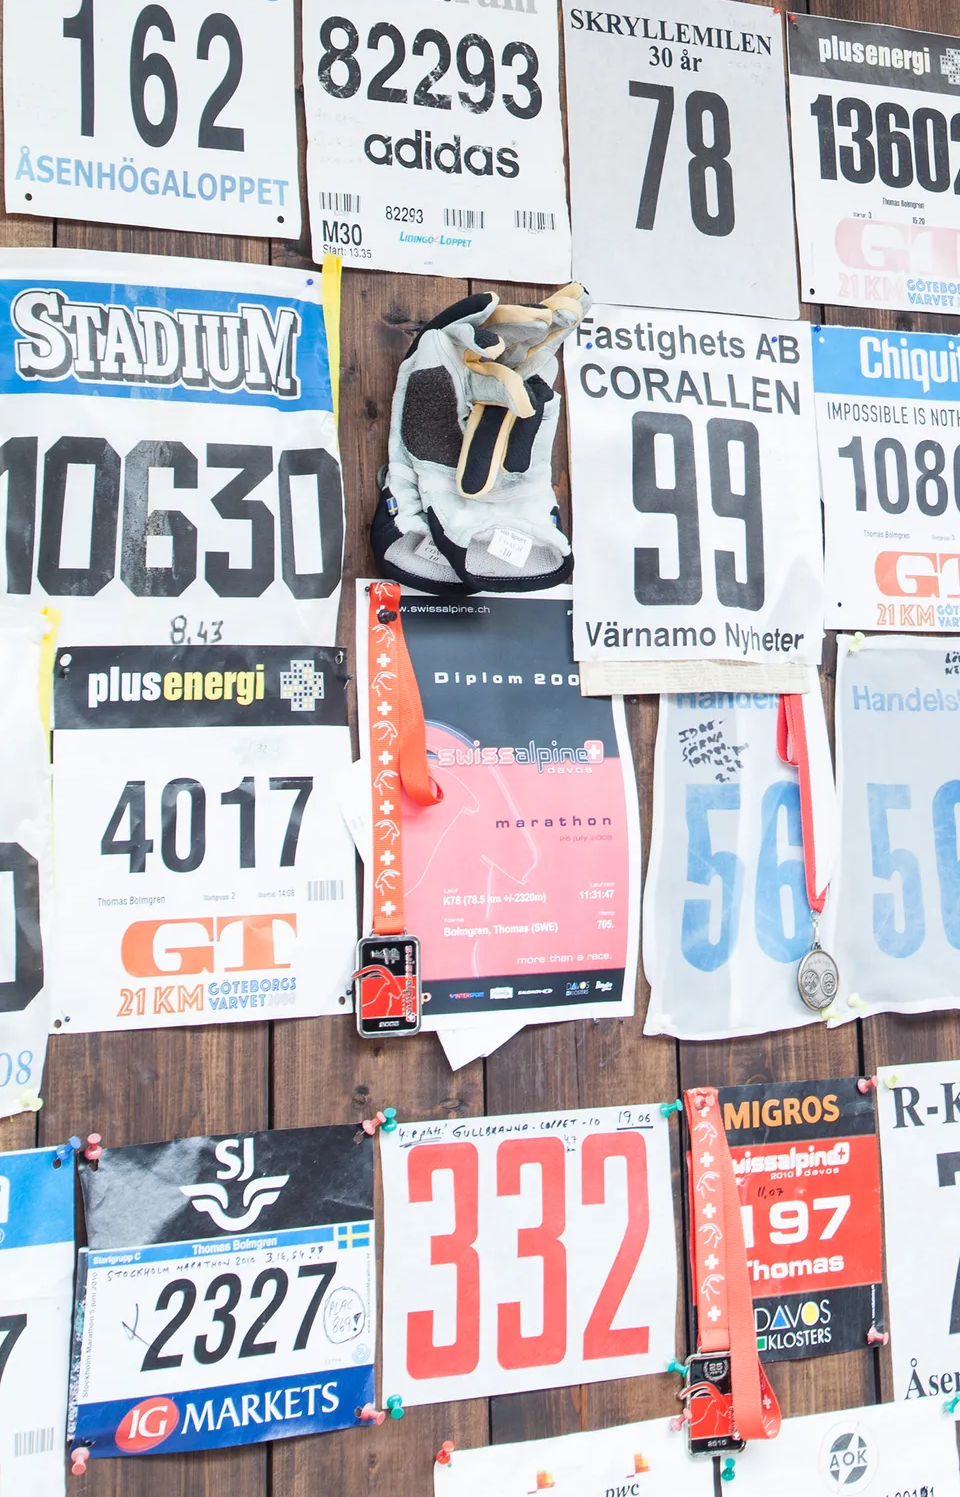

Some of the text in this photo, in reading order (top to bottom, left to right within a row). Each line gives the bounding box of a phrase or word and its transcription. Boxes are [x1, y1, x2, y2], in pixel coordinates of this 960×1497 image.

[570, 8, 772, 56] SKRYLLEMILEN
[317, 15, 543, 120] 82293
[648, 46, 702, 72] 30 år
[818, 35, 931, 74] plusenergi
[364, 129, 520, 178] adidas
[628, 80, 735, 237] 78
[15, 146, 289, 207] ÅSENHÖGALOPPET
[385, 205, 424, 224] 82293
[322, 219, 363, 246] M30
[439, 234, 472, 247] LOPPET
[322, 243, 372, 259] Start: 13.35
[907, 292, 954, 307] VARVET
[13, 288, 300, 399] STADIUM
[574, 317, 800, 364] Fastighets AB
[579, 363, 800, 416] CORALLEN
[826, 401, 927, 426] IMPOSSIBLE IS
[0, 436, 345, 598] 10630
[631, 411, 766, 612] 99
[876, 603, 895, 626] 21
[900, 604, 935, 627] KM
[585, 621, 805, 654] Värnamo Nyheter
[88, 664, 266, 708] plusenergi
[434, 671, 523, 686] Diplom
[438, 740, 590, 774] swissalpine
[547, 766, 592, 774] davos
[100, 776, 314, 874] 4017
[495, 816, 612, 829] marathon
[97, 895, 166, 907] Thomas Bolmgren
[493, 924, 529, 934] Thomas
[531, 922, 559, 934] (SWE)
[121, 913, 298, 978] GT
[516, 956, 546, 965] more
[549, 954, 573, 963] than
[586, 952, 613, 961] race.
[116, 977, 297, 1017] 21 KM GÖTEBORGS
[208, 993, 267, 1011] VARVET
[723, 1094, 840, 1131] MIGROS
[214, 1137, 255, 1182] SJ
[770, 1166, 840, 1181] 2010 davos
[741, 1195, 851, 1249] 197
[93, 1255, 133, 1267] Startgrupp
[192, 1237, 278, 1256] Thomas Bolmgren
[406, 1131, 651, 1381] 332
[106, 1266, 170, 1282] STOCKHOLM
[140, 1262, 338, 1372] 2327
[768, 1327, 832, 1351] KLOSTERS
[127, 1381, 340, 1439] IG MARKETS
[828, 1449, 869, 1469] AOK
[605, 1481, 641, 1497] pwc
